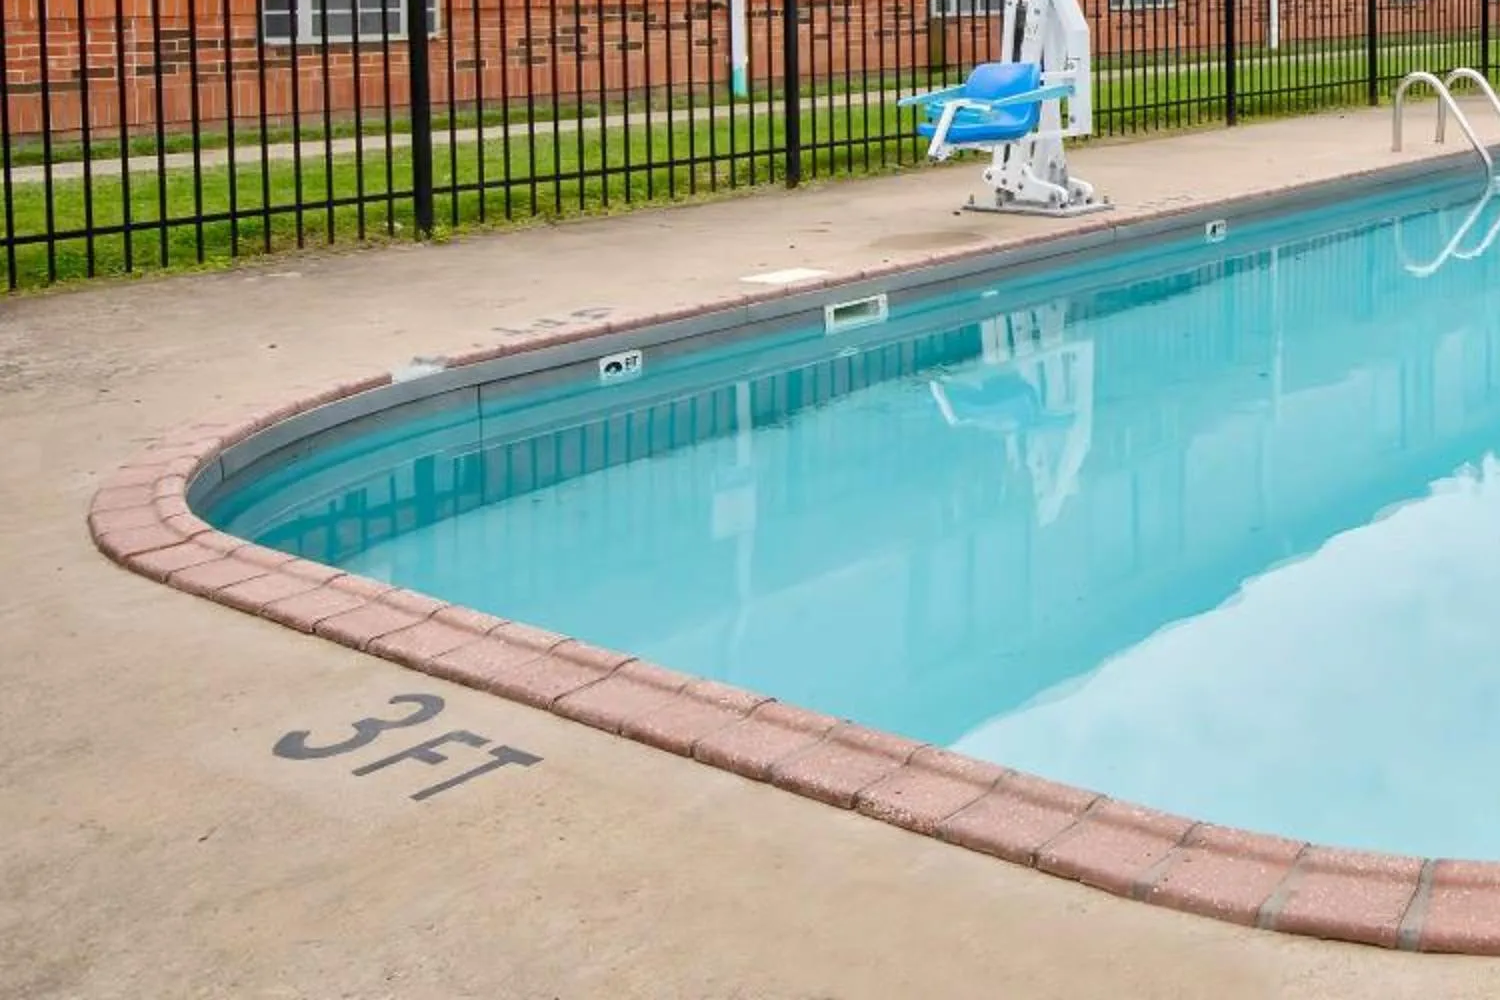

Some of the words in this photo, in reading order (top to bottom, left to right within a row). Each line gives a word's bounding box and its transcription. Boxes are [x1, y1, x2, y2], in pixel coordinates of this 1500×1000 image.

[625, 354, 639, 370] FT
[272, 693, 446, 760] 3
[352, 729, 544, 801] FT
